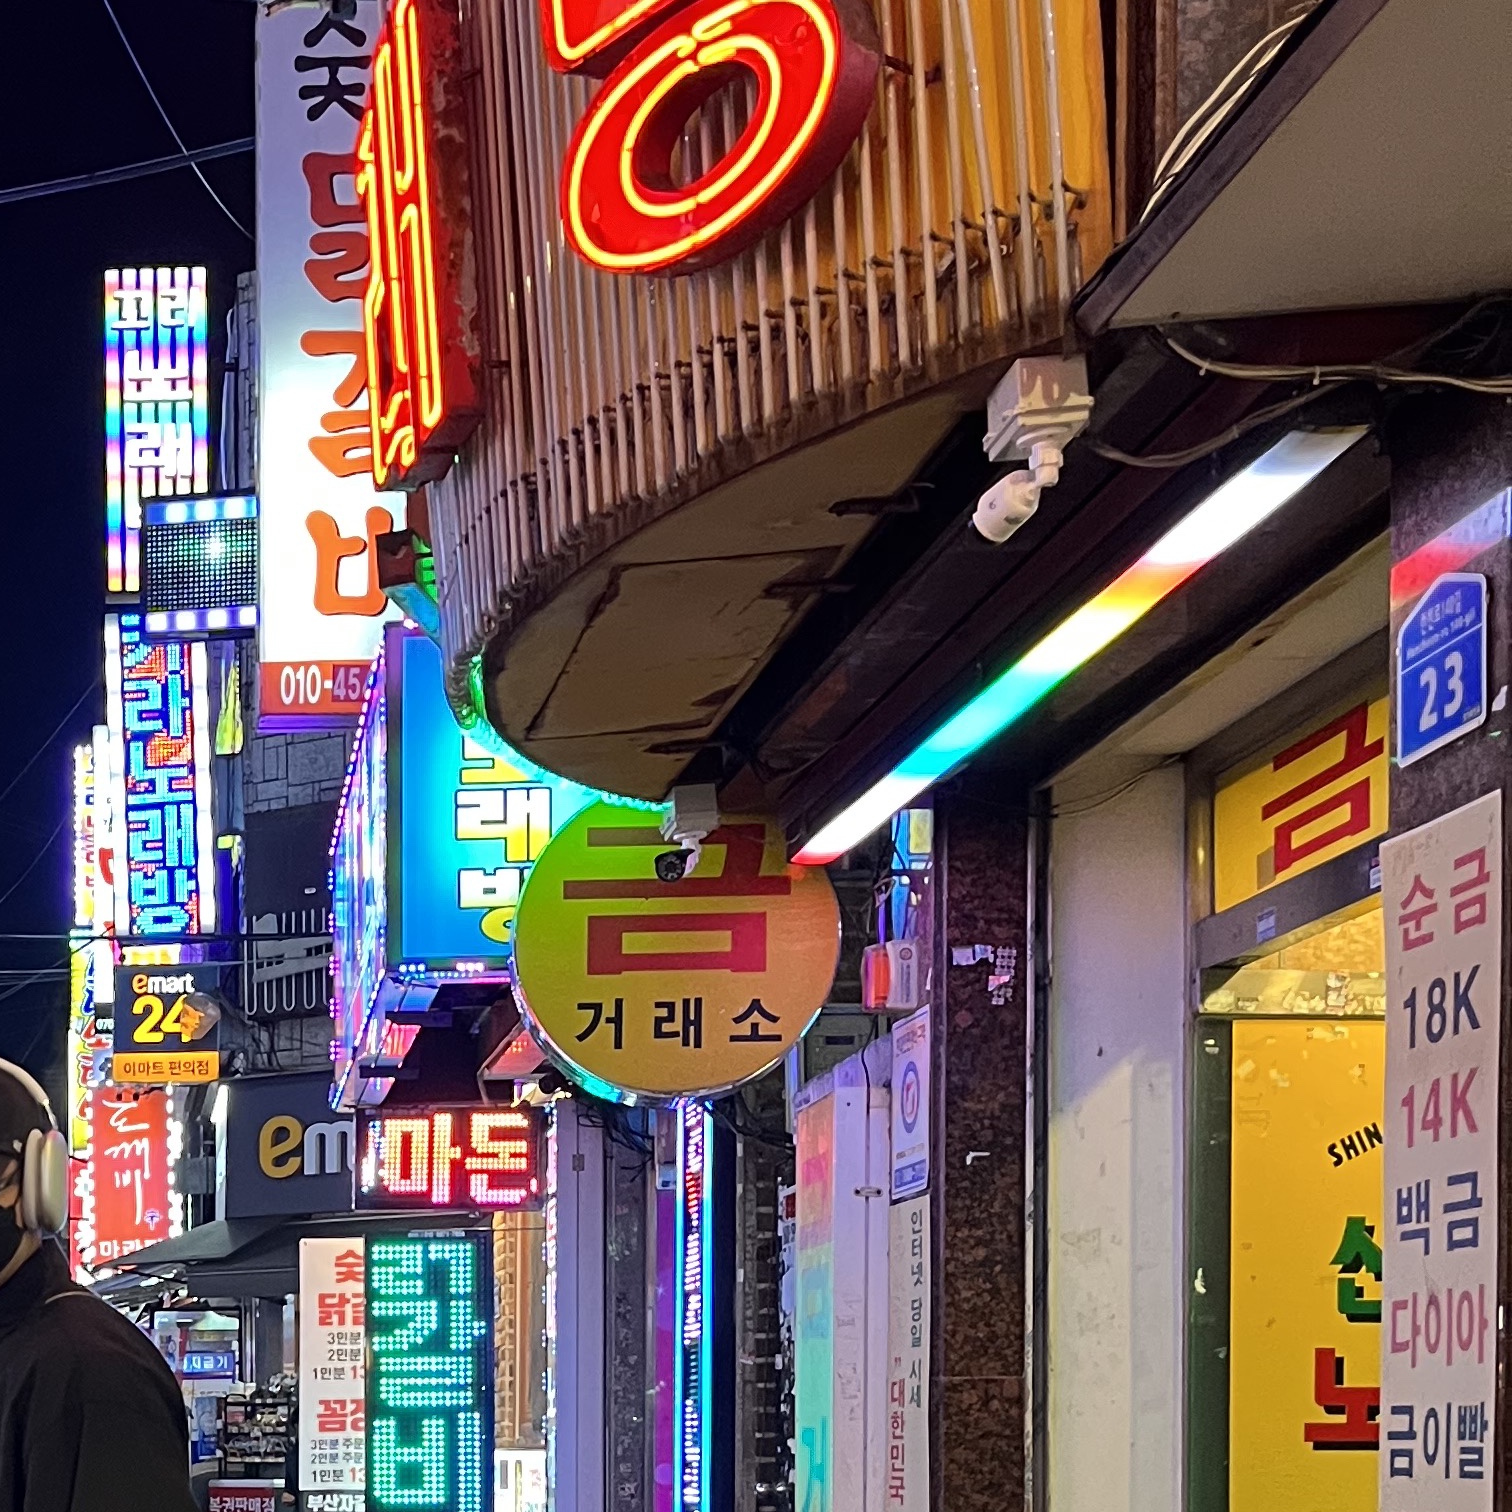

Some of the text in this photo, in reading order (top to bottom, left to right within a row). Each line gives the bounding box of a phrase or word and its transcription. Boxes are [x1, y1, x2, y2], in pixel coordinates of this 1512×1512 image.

[122, 349, 194, 480] 노래
[280, 664, 368, 705] 010-45
[1419, 651, 1464, 733] 23
[1262, 702, 1384, 875] 금
[563, 823, 791, 976] 금
[1397, 847, 1491, 952] 순금
[131, 972, 195, 994] emart
[132, 995, 196, 1043] 24
[1402, 963, 1482, 1050] 18K
[574, 997, 784, 1051] 거래소
[122, 1057, 210, 1077] 이마트 편의점
[1400, 1066, 1479, 1149] 14K
[258, 1114, 354, 1179] em
[99, 1239, 166, 1259] 마라
[1395, 1171, 1483, 1256] 백금
[911, 1297, 922, 1348] 당일
[1390, 1283, 1488, 1369] 다이아
[312, 1367, 345, 1381] 1인분
[311, 1469, 344, 1483] 1인분
[1387, 1401, 1488, 1480] 금이빨
